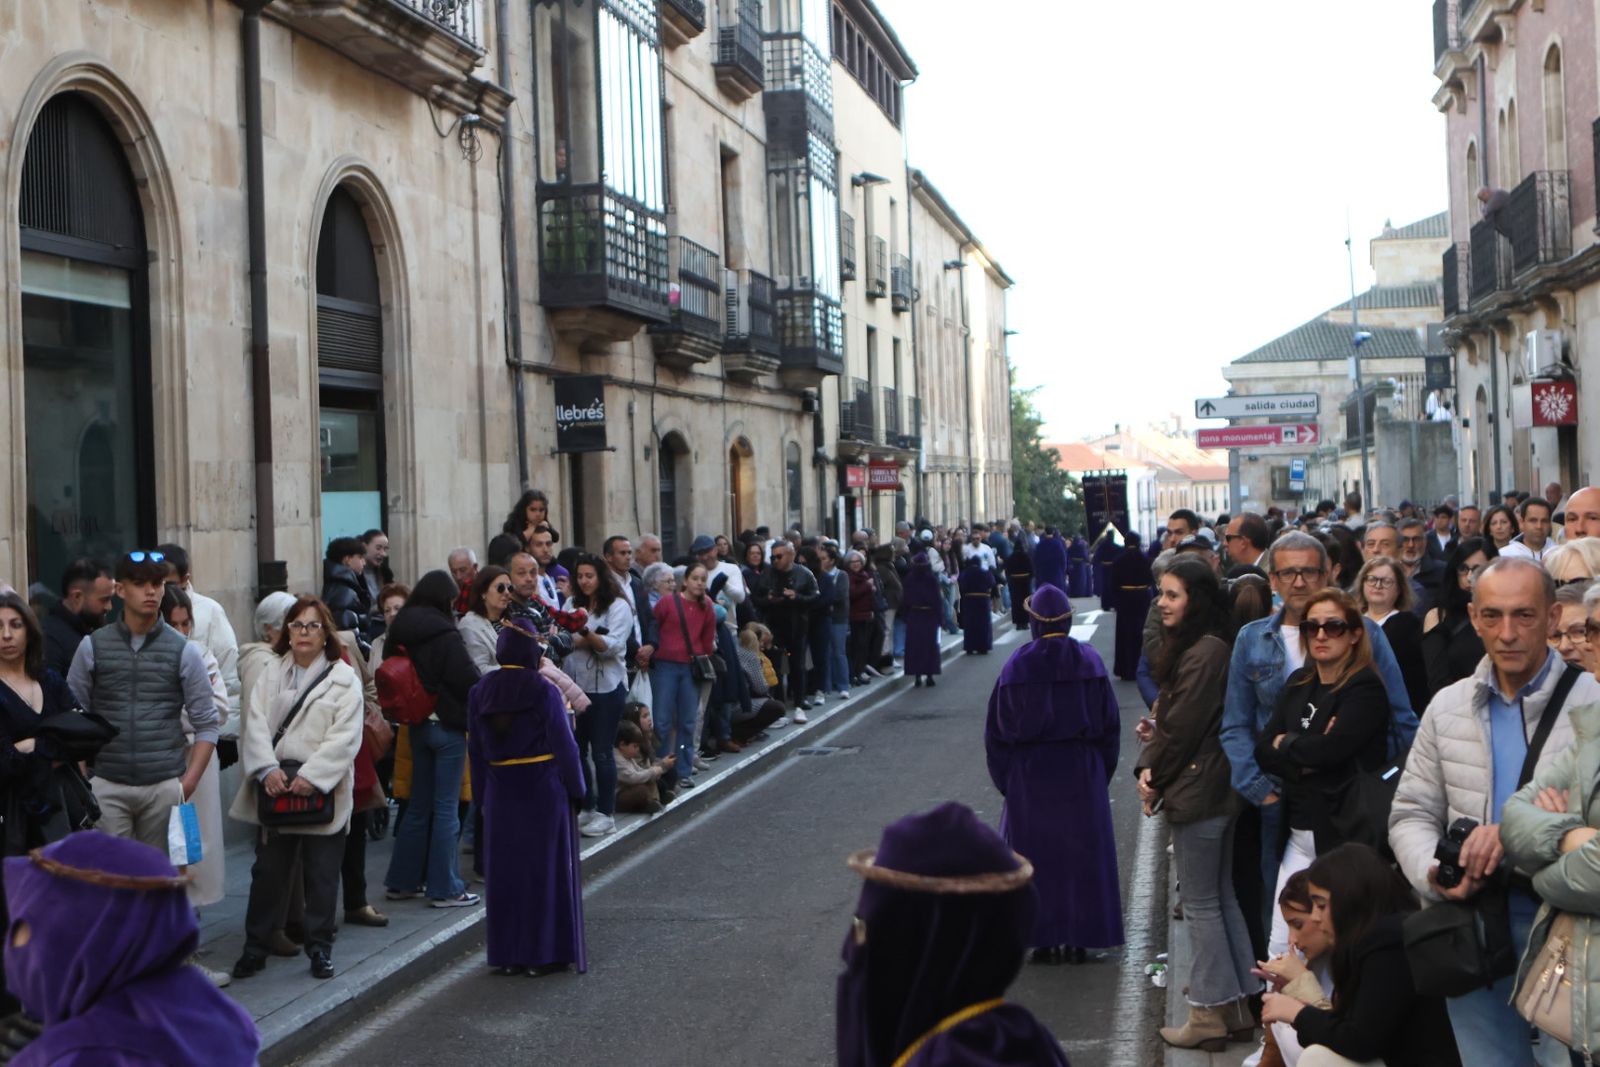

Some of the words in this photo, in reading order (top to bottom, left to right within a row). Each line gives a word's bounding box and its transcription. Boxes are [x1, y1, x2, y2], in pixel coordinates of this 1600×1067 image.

[1245, 400, 1276, 411] salida
[1280, 399, 1316, 409] ciudad
[556, 403, 604, 421] llebrés
[1201, 434, 1220, 443] zona
[1222, 432, 1275, 442] monumental
